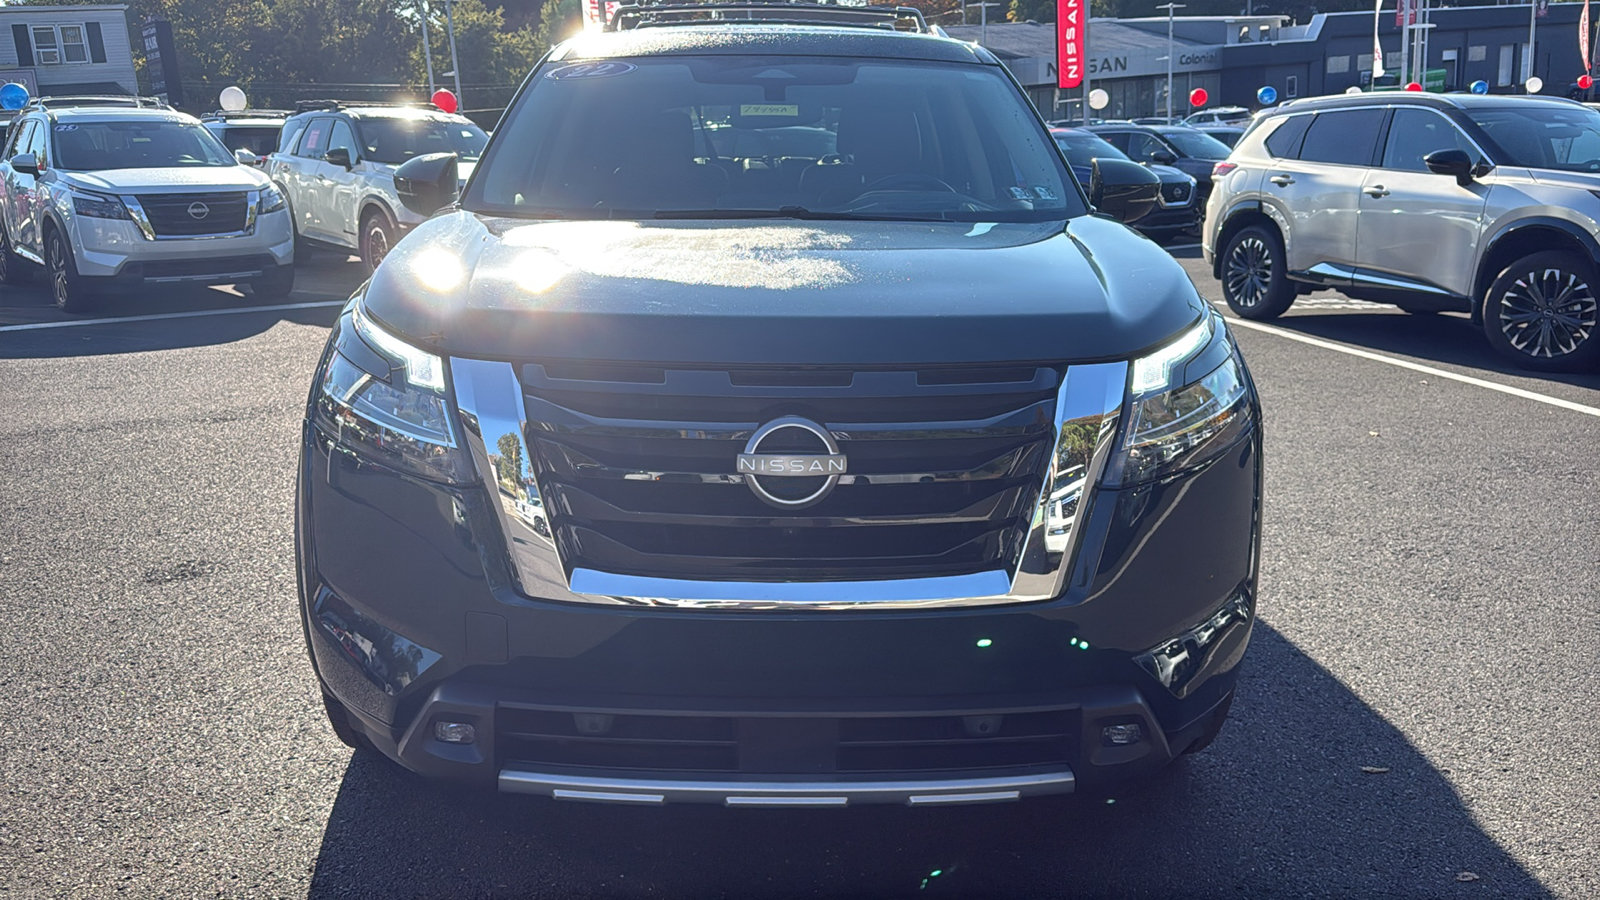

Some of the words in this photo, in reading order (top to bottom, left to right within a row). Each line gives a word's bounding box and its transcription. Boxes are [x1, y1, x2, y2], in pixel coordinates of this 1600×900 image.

[1180, 51, 1217, 65] Colonial
[565, 63, 615, 77] 22
[1046, 56, 1128, 77] NSAN
[740, 458, 844, 472] NISSAN
